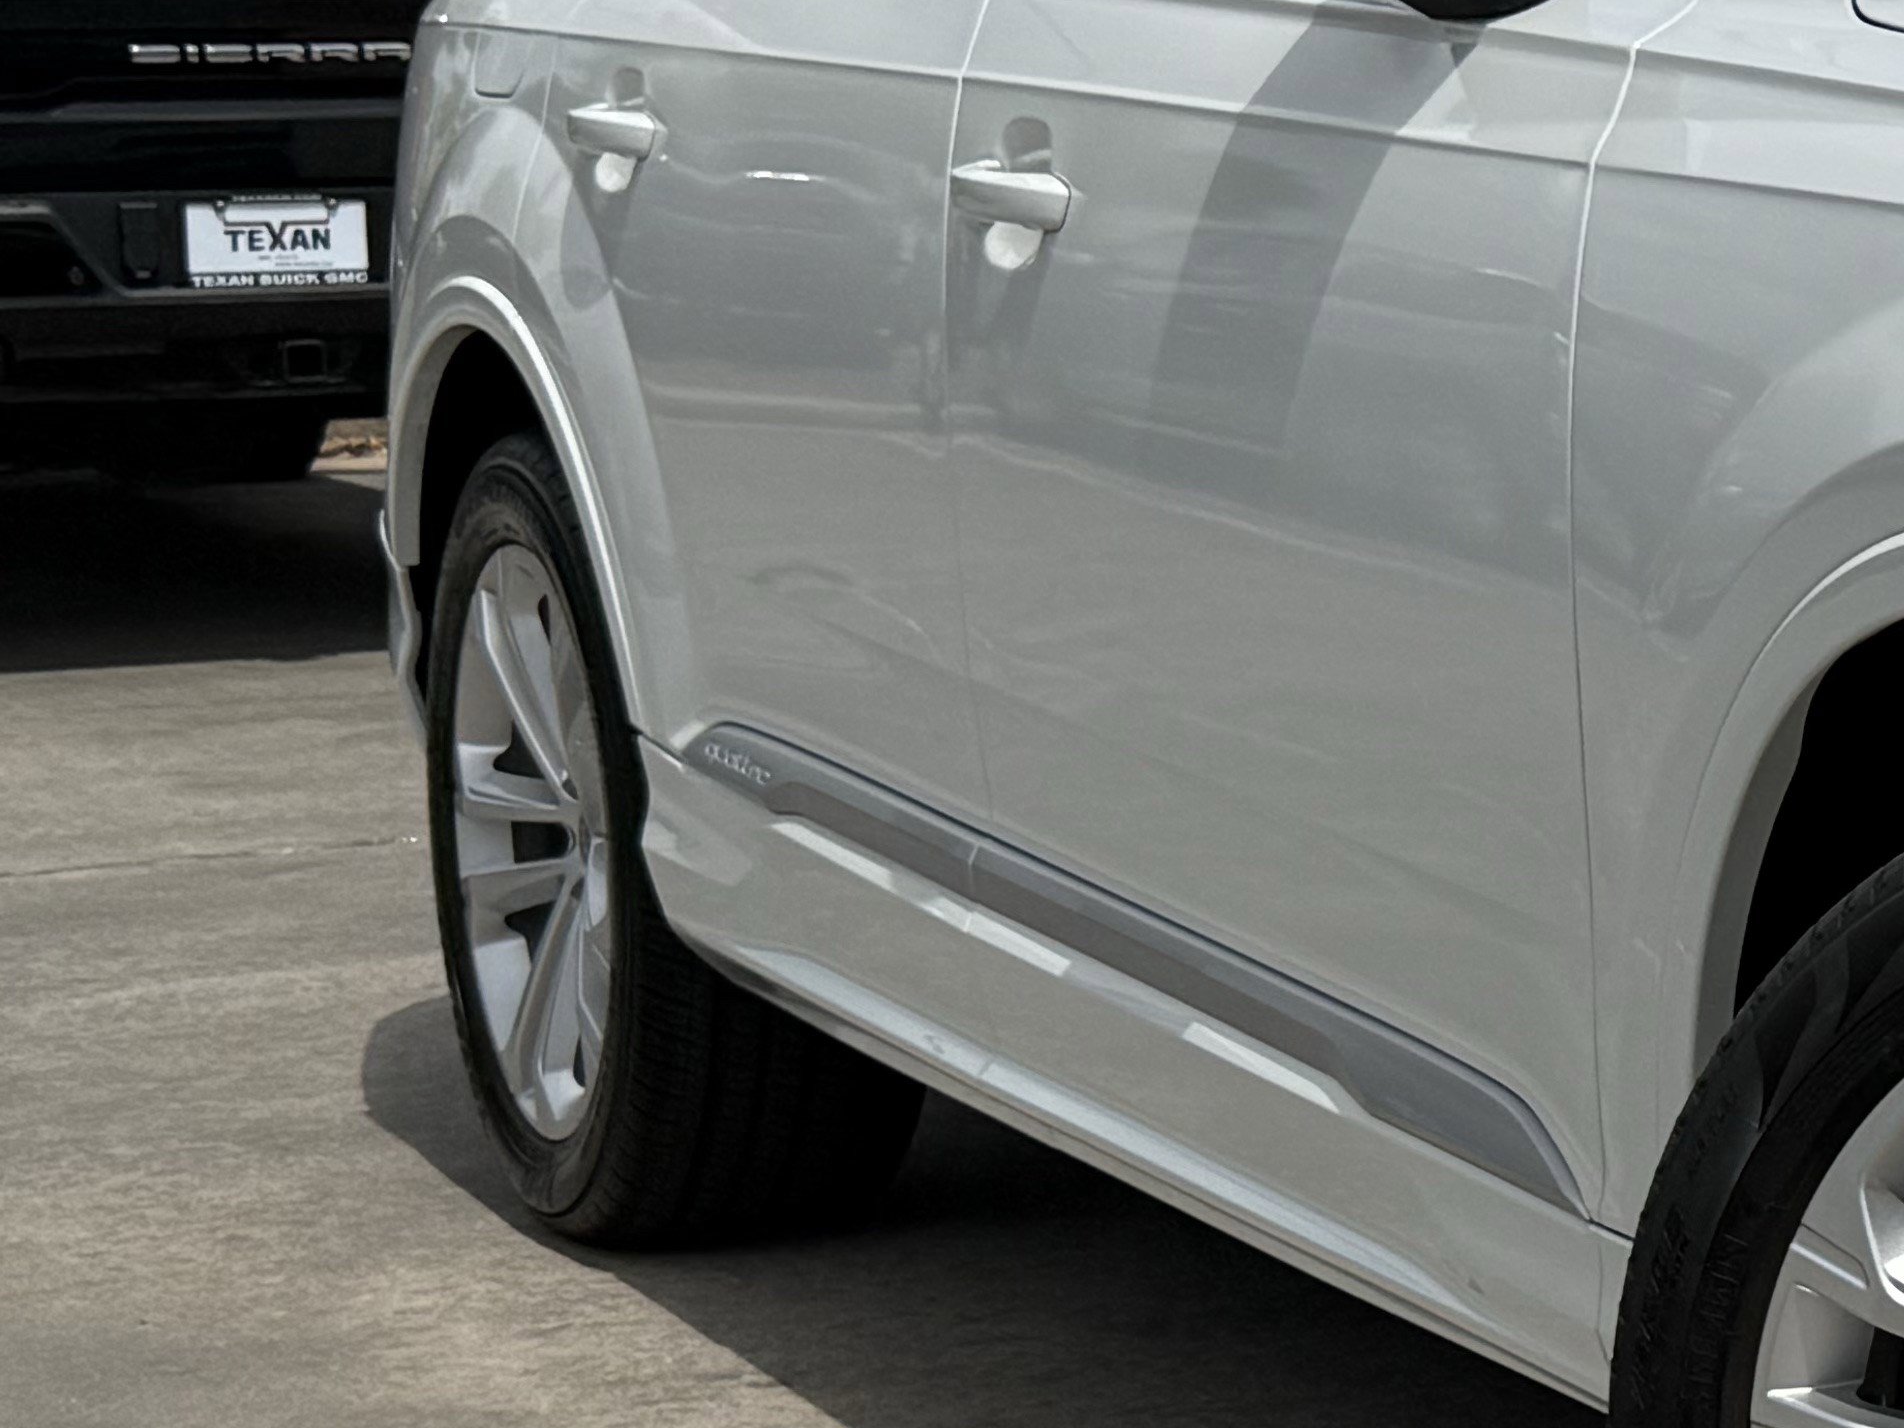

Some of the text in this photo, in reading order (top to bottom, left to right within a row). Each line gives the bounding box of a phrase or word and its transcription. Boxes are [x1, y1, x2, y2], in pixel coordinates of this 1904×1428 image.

[223, 224, 332, 253] TEXAN
[191, 271, 369, 288] TEXAN BUICK GMC
